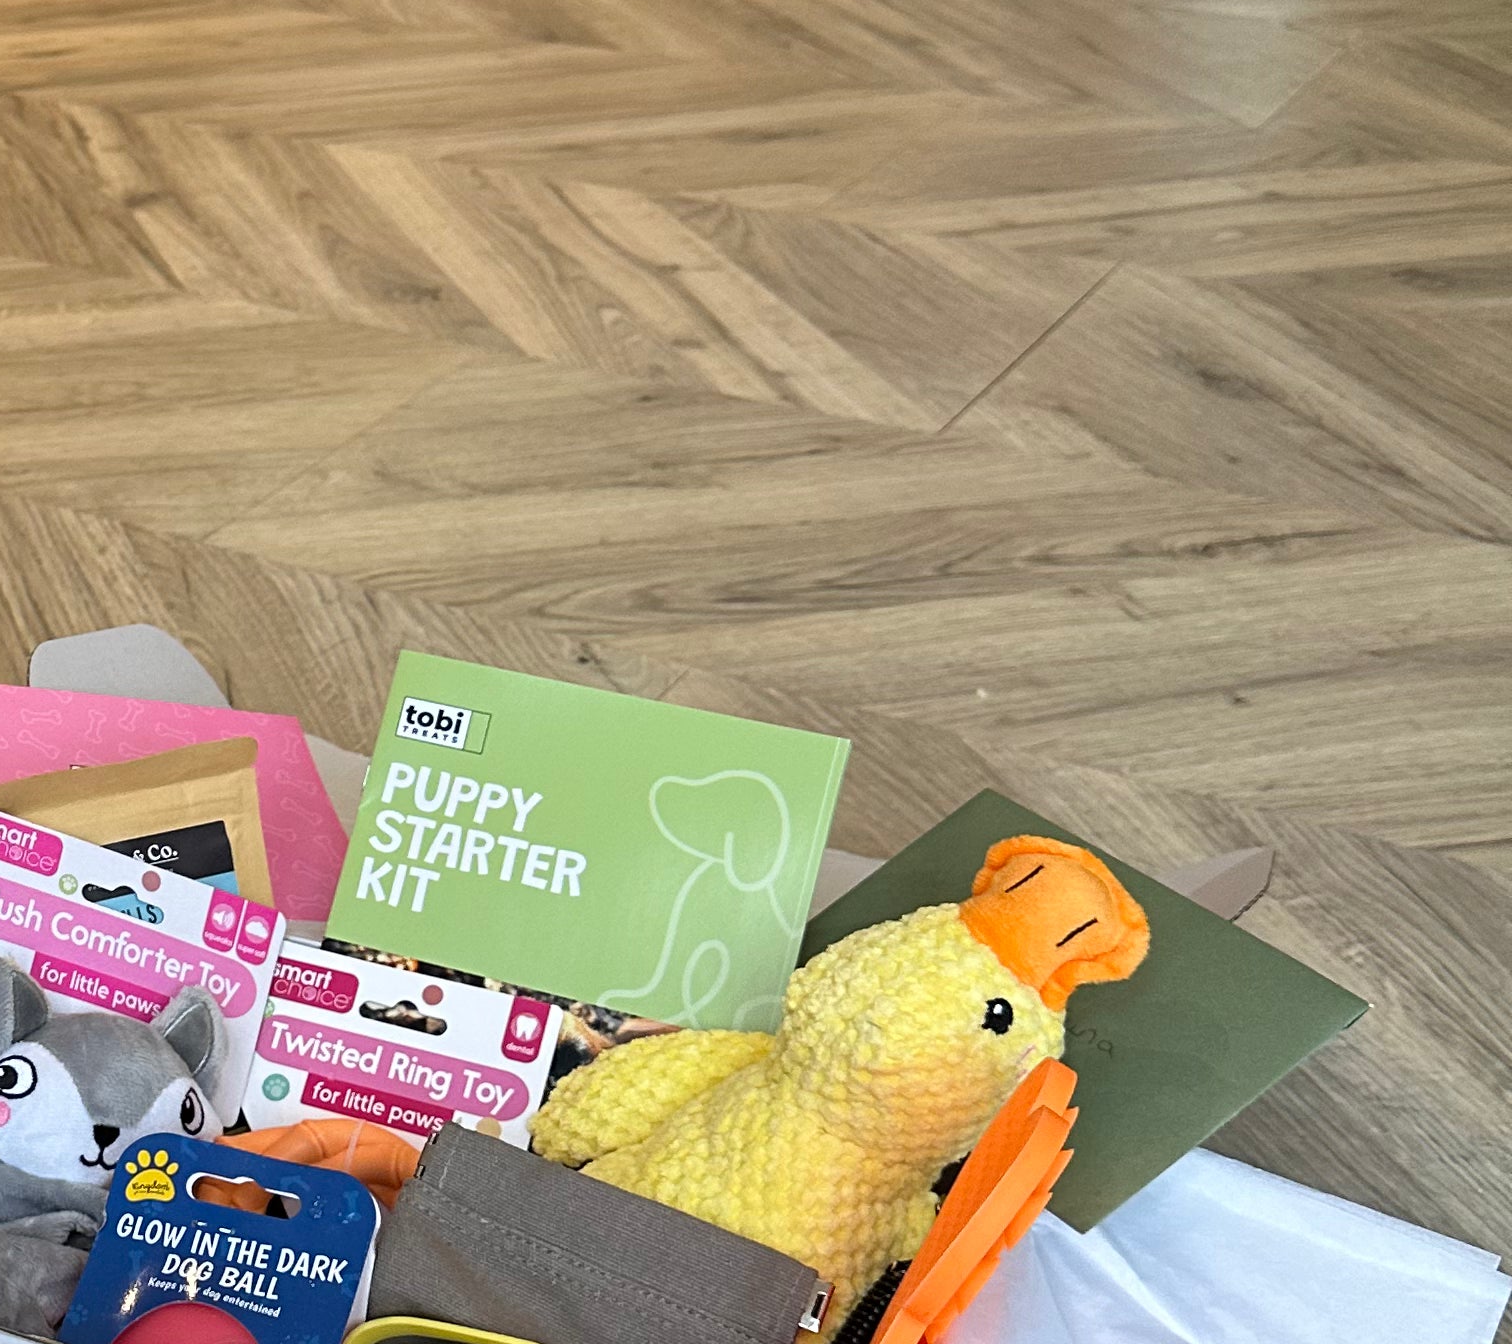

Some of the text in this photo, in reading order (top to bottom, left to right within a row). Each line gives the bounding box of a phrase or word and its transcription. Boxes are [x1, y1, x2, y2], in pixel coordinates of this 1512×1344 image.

[403, 725, 458, 744] TREATS
[406, 705, 464, 734] tobi
[381, 762, 544, 832] PUPPY
[147, 844, 178, 861] Co.
[368, 809, 587, 897] STARTER
[356, 856, 441, 913] KIT
[51, 912, 194, 982] Comforter
[199, 961, 240, 1008] Toy
[39, 961, 161, 1017] for little paws
[274, 979, 350, 1009] choice
[272, 1021, 515, 1116] Twisted Ring Toy
[312, 1081, 444, 1131] for little paws
[116, 1213, 348, 1284] GLOW IN THE DARK
[148, 1276, 177, 1291] Keeps
[202, 1286, 221, 1301] dog
[223, 1294, 281, 1318] entertained
[161, 1253, 279, 1300] DOG BALL
